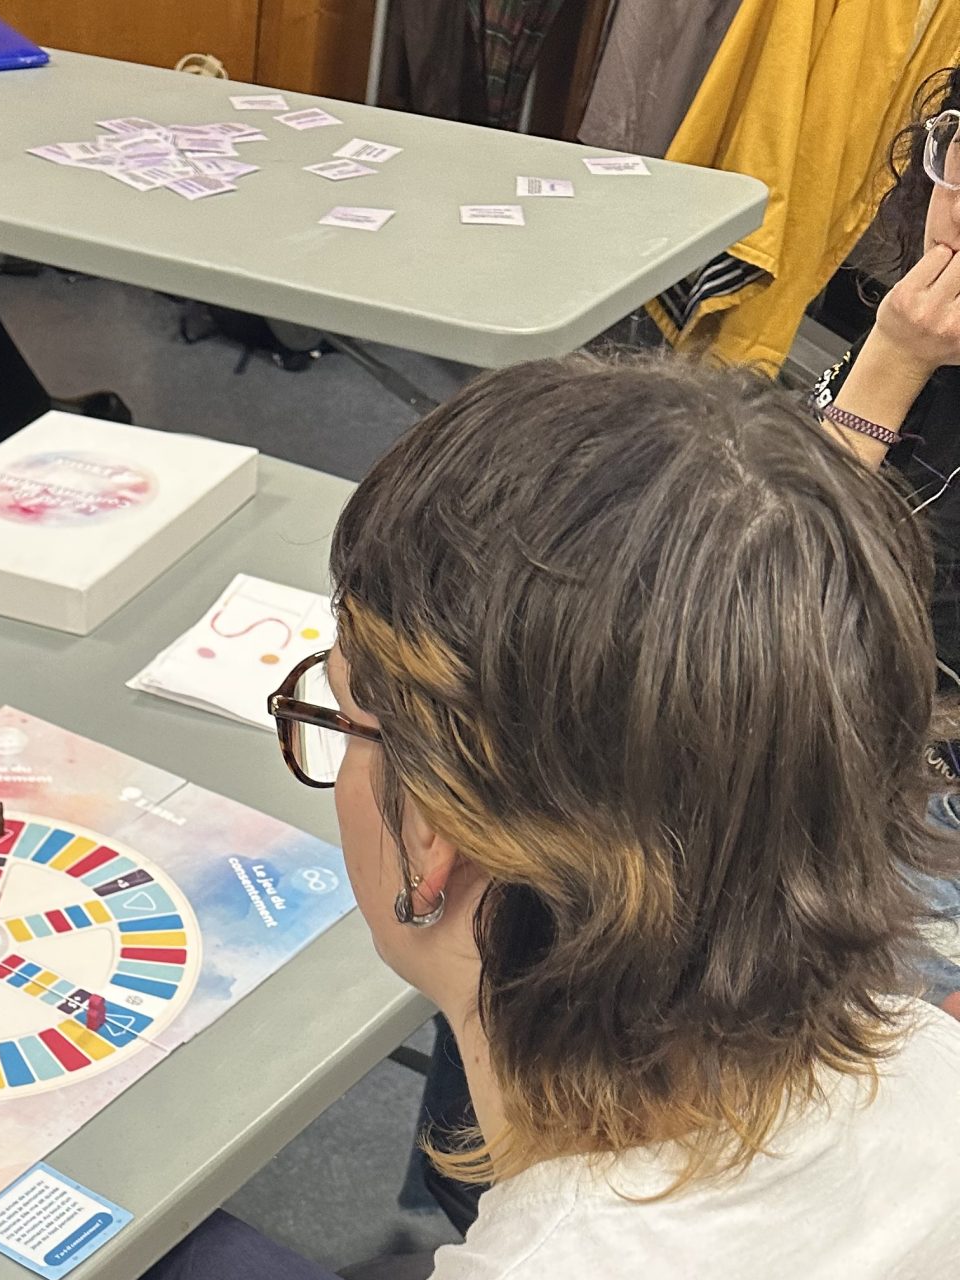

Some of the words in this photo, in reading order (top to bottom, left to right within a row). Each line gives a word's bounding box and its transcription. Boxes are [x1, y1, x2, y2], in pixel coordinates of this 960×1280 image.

[252, 865, 266, 878] Le
[229, 857, 278, 928] consentement
[256, 878, 277, 895] jeu
[271, 895, 286, 910] du
